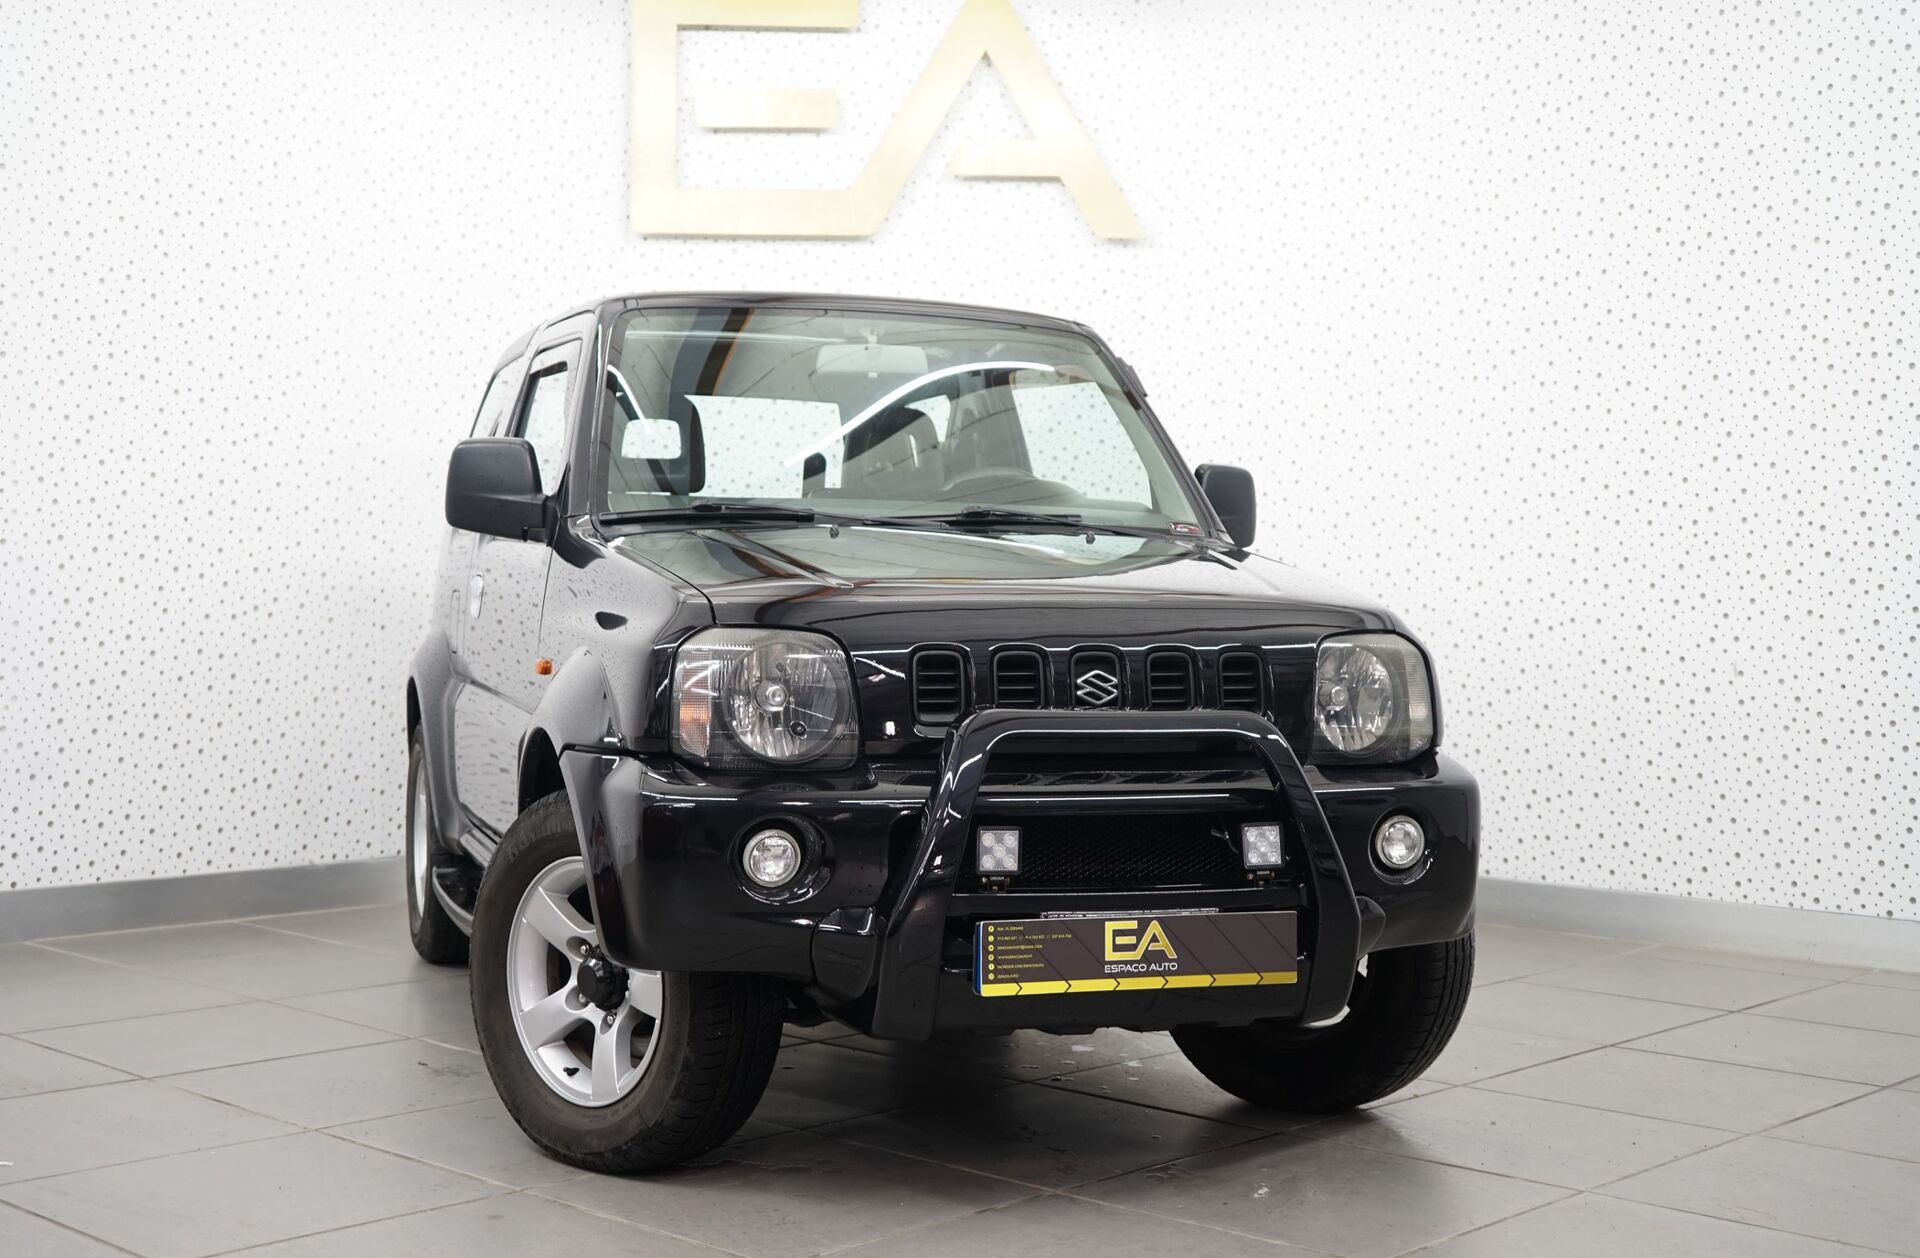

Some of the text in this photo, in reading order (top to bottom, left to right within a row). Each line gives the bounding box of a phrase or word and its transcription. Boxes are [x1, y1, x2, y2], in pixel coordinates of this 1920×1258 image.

[630, 0, 1147, 240] EA
[1104, 919, 1178, 961] EA
[1148, 962, 1178, 971] AUTO
